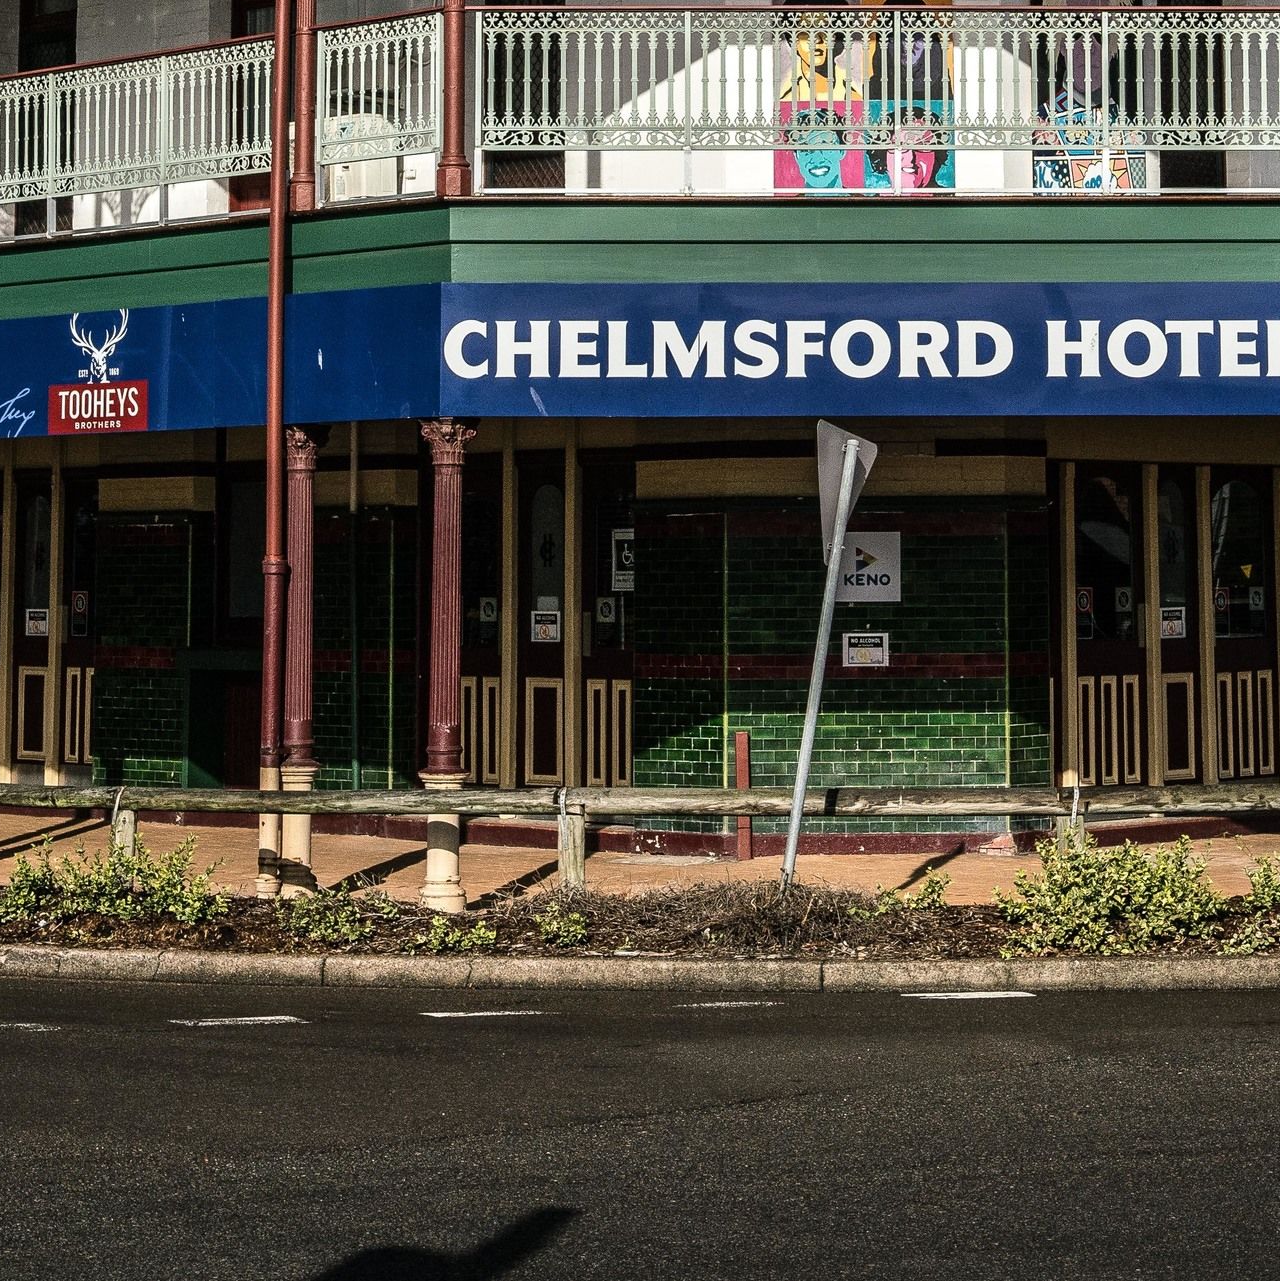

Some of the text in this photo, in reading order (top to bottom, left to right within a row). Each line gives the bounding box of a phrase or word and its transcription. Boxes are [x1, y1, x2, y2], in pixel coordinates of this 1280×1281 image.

[443, 319, 1015, 380] CHELMSFORD
[58, 387, 139, 420] TOOHEYS
[74, 419, 122, 430] BROTHERS
[843, 573, 892, 587] KENO
